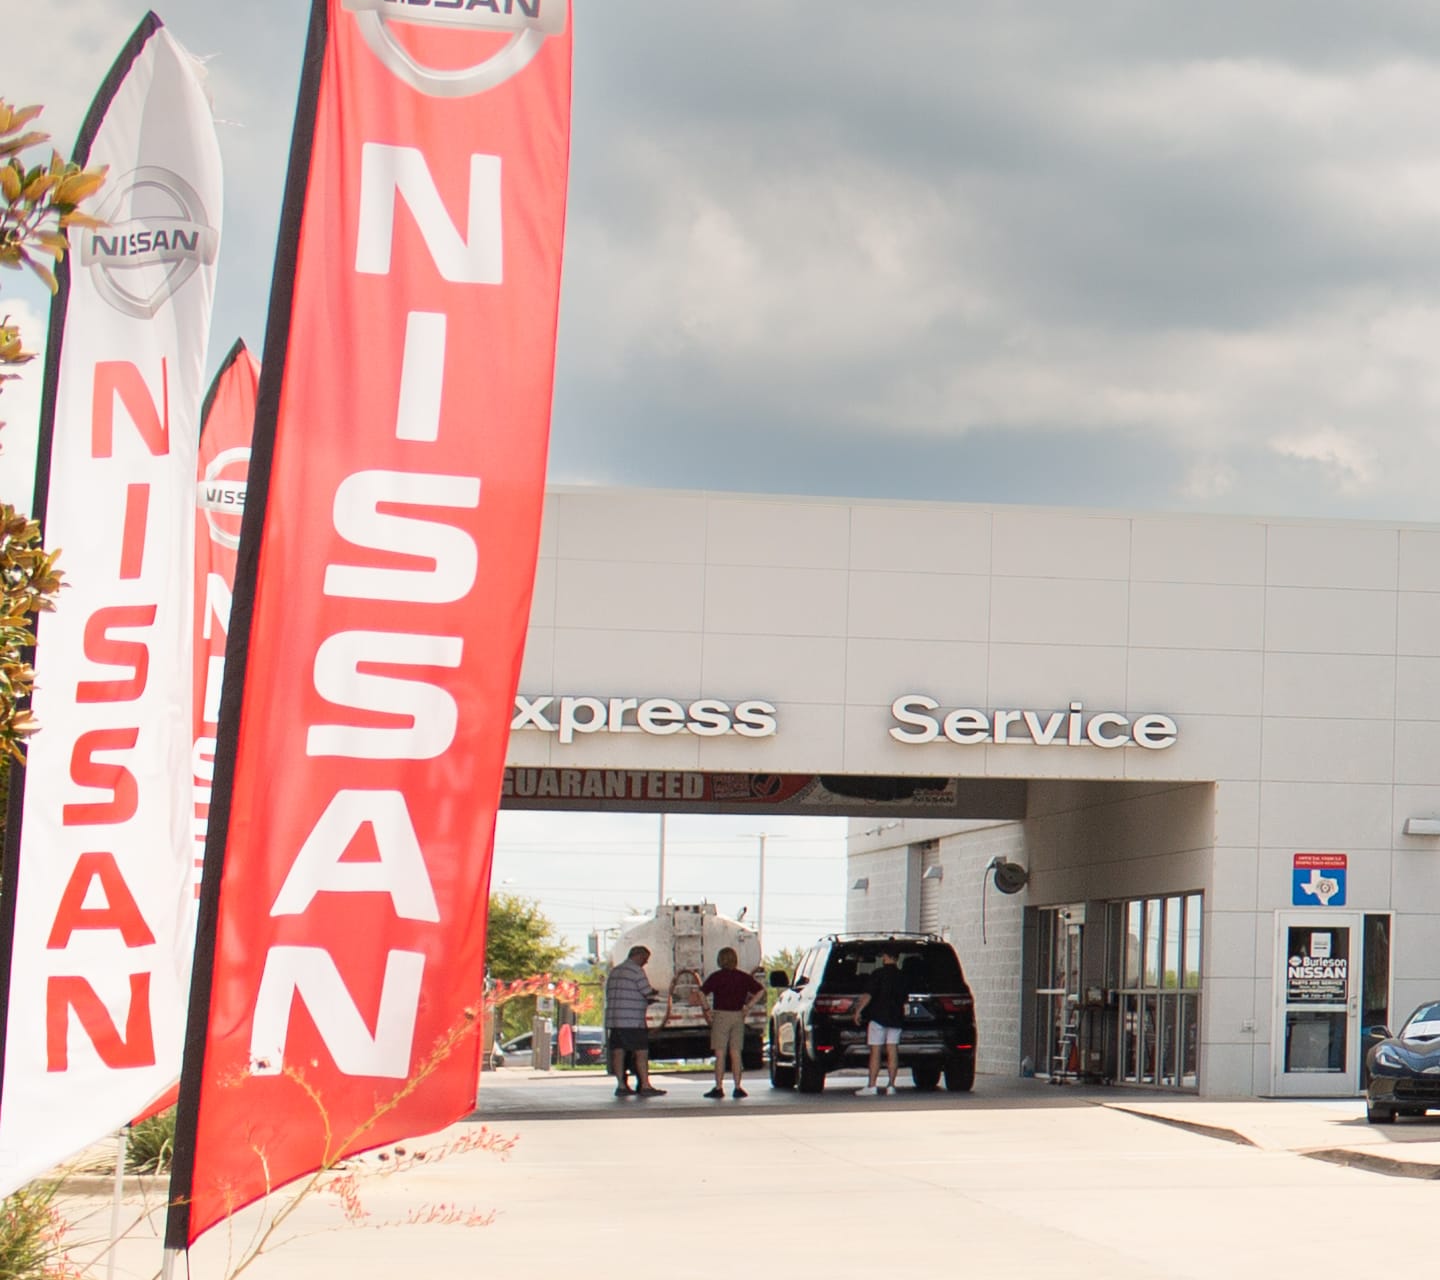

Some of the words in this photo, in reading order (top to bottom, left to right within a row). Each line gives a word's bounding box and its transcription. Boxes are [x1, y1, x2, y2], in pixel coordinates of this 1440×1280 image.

[91, 229, 199, 256] NISSAN
[249, 141, 503, 1080] NISSAN
[46, 357, 170, 1073] NISSAN
[510, 695, 777, 744] xpress
[889, 693, 1179, 750] Service
[1288, 966, 1347, 979] NISSAN
[1303, 956, 1347, 967] Burleson
